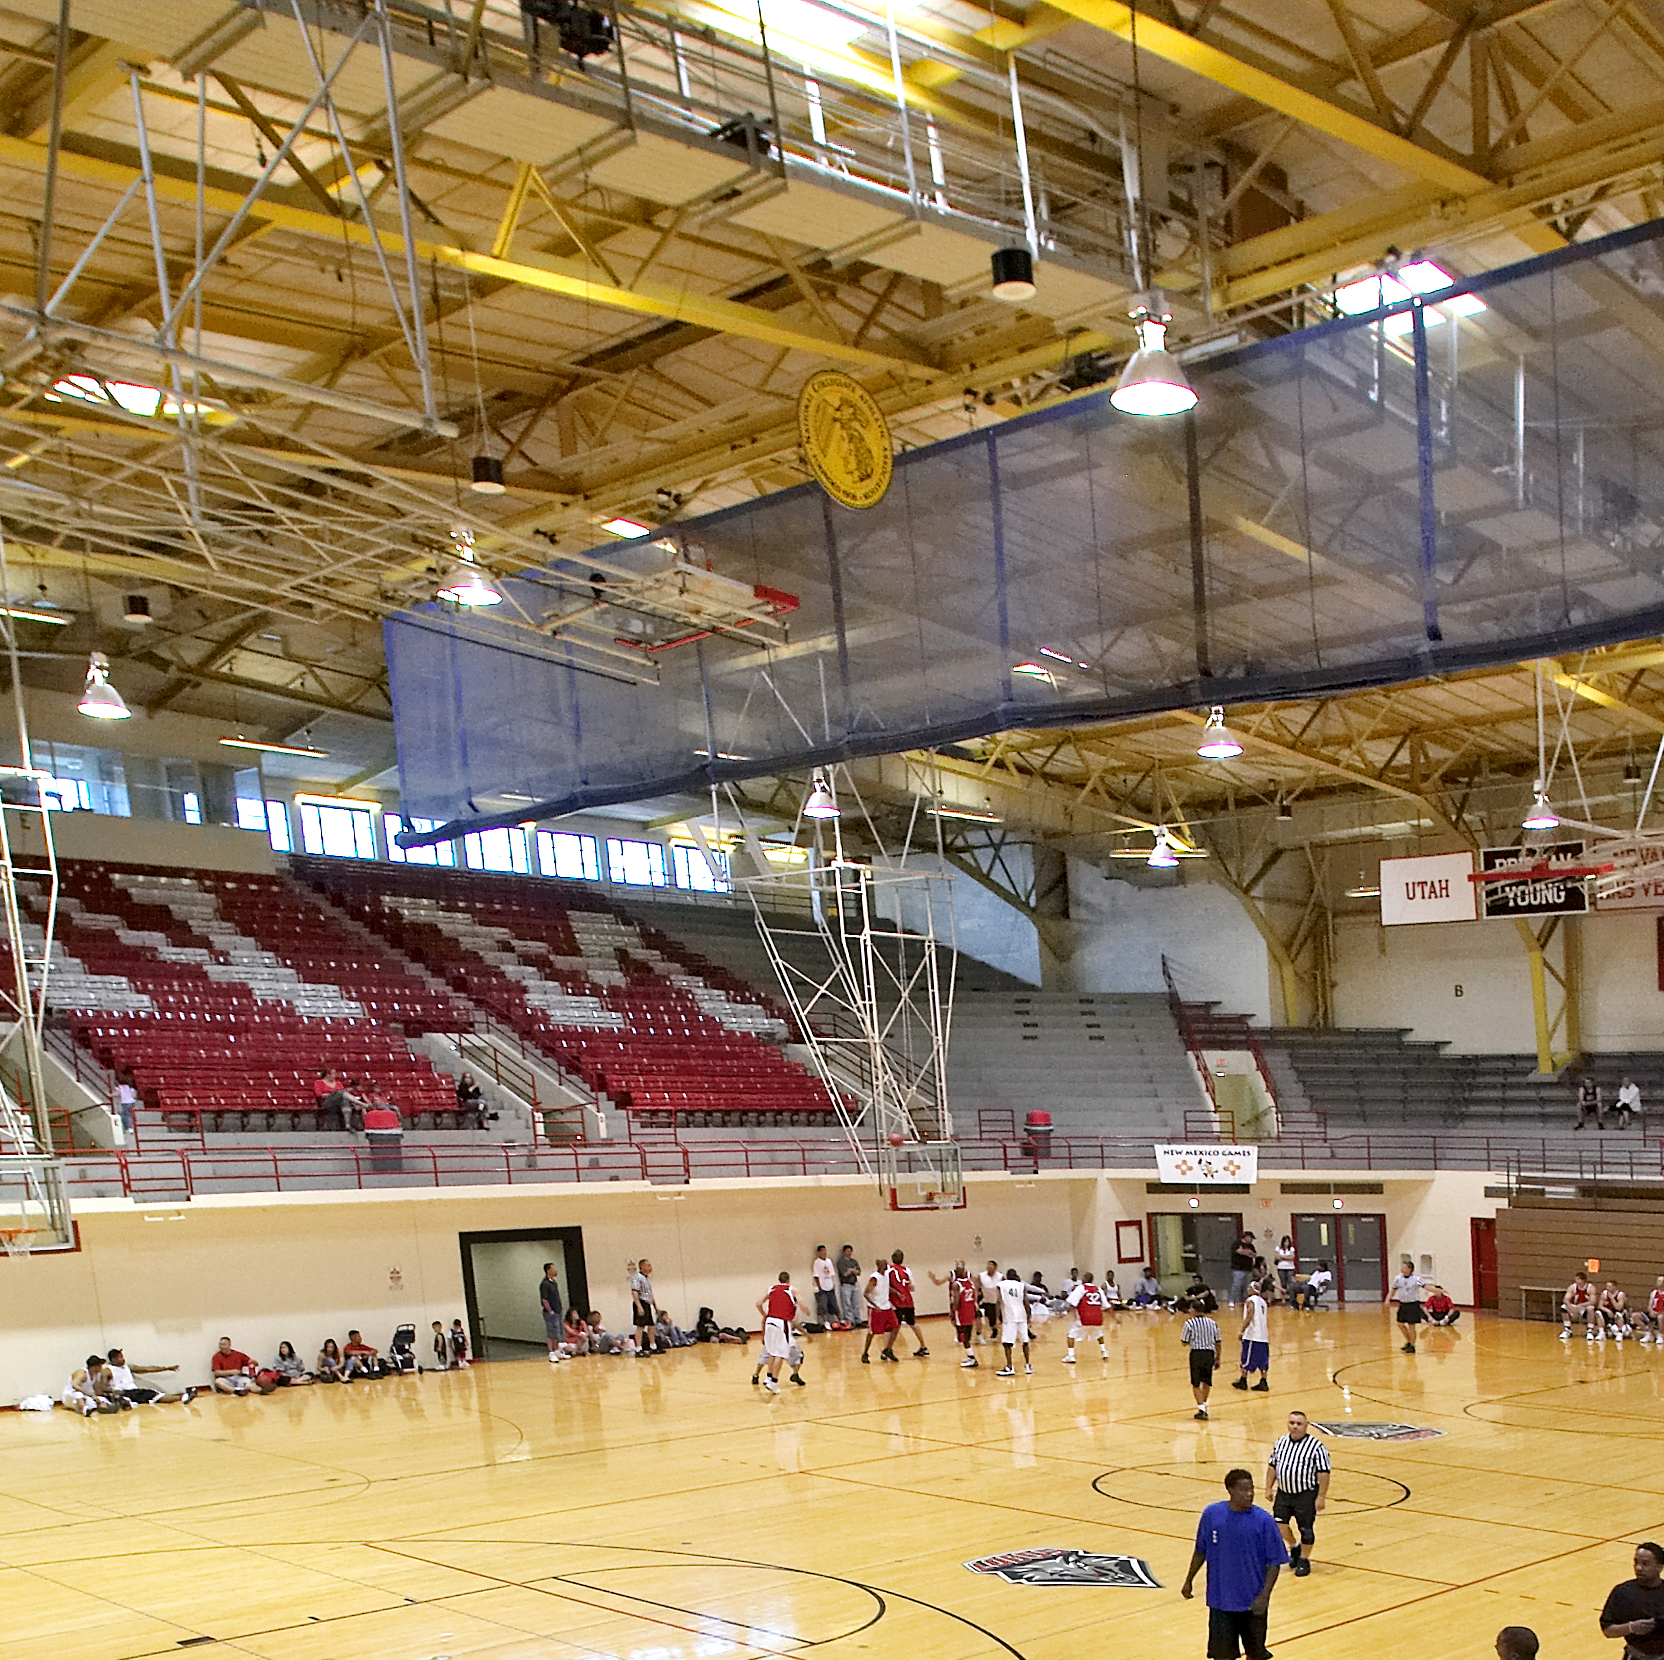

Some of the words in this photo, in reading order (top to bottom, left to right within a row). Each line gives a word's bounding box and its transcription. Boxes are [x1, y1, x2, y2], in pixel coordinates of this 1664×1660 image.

[1405, 879, 1450, 900] UTAH
[1504, 882, 1566, 907] YOUNG
[1455, 985, 1464, 997] B
[1008, 1286, 1019, 1298] 41
[1086, 1292, 1101, 1305] 32
